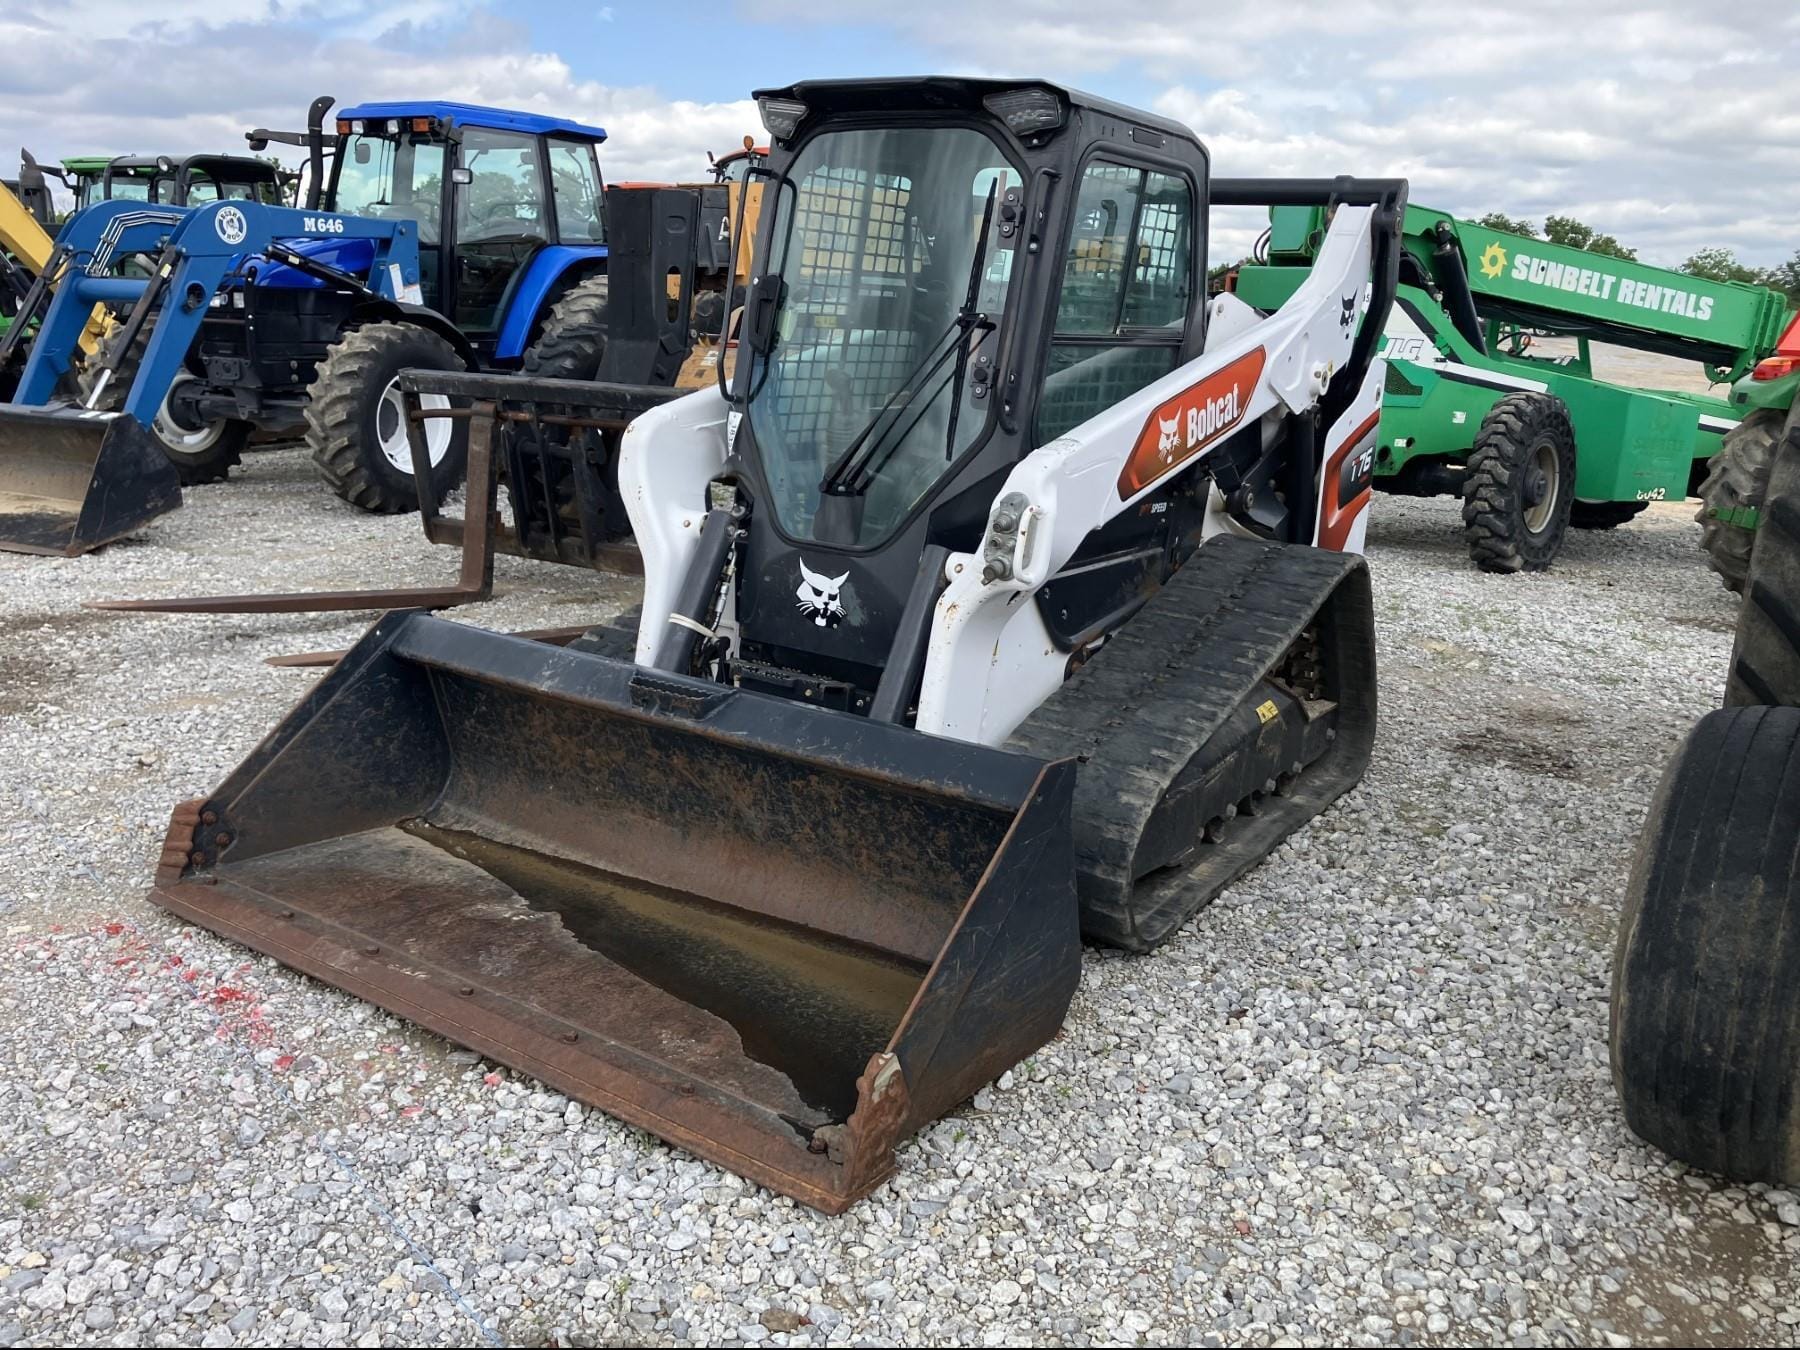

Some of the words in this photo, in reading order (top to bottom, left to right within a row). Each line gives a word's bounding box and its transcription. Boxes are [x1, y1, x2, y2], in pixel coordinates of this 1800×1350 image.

[1511, 253, 1616, 300] SUNBELT
[1616, 278, 1714, 321] RENTALS
[1378, 337, 1425, 360] JLG
[1187, 382, 1239, 449] Bobcat
[1350, 446, 1374, 482] T76
